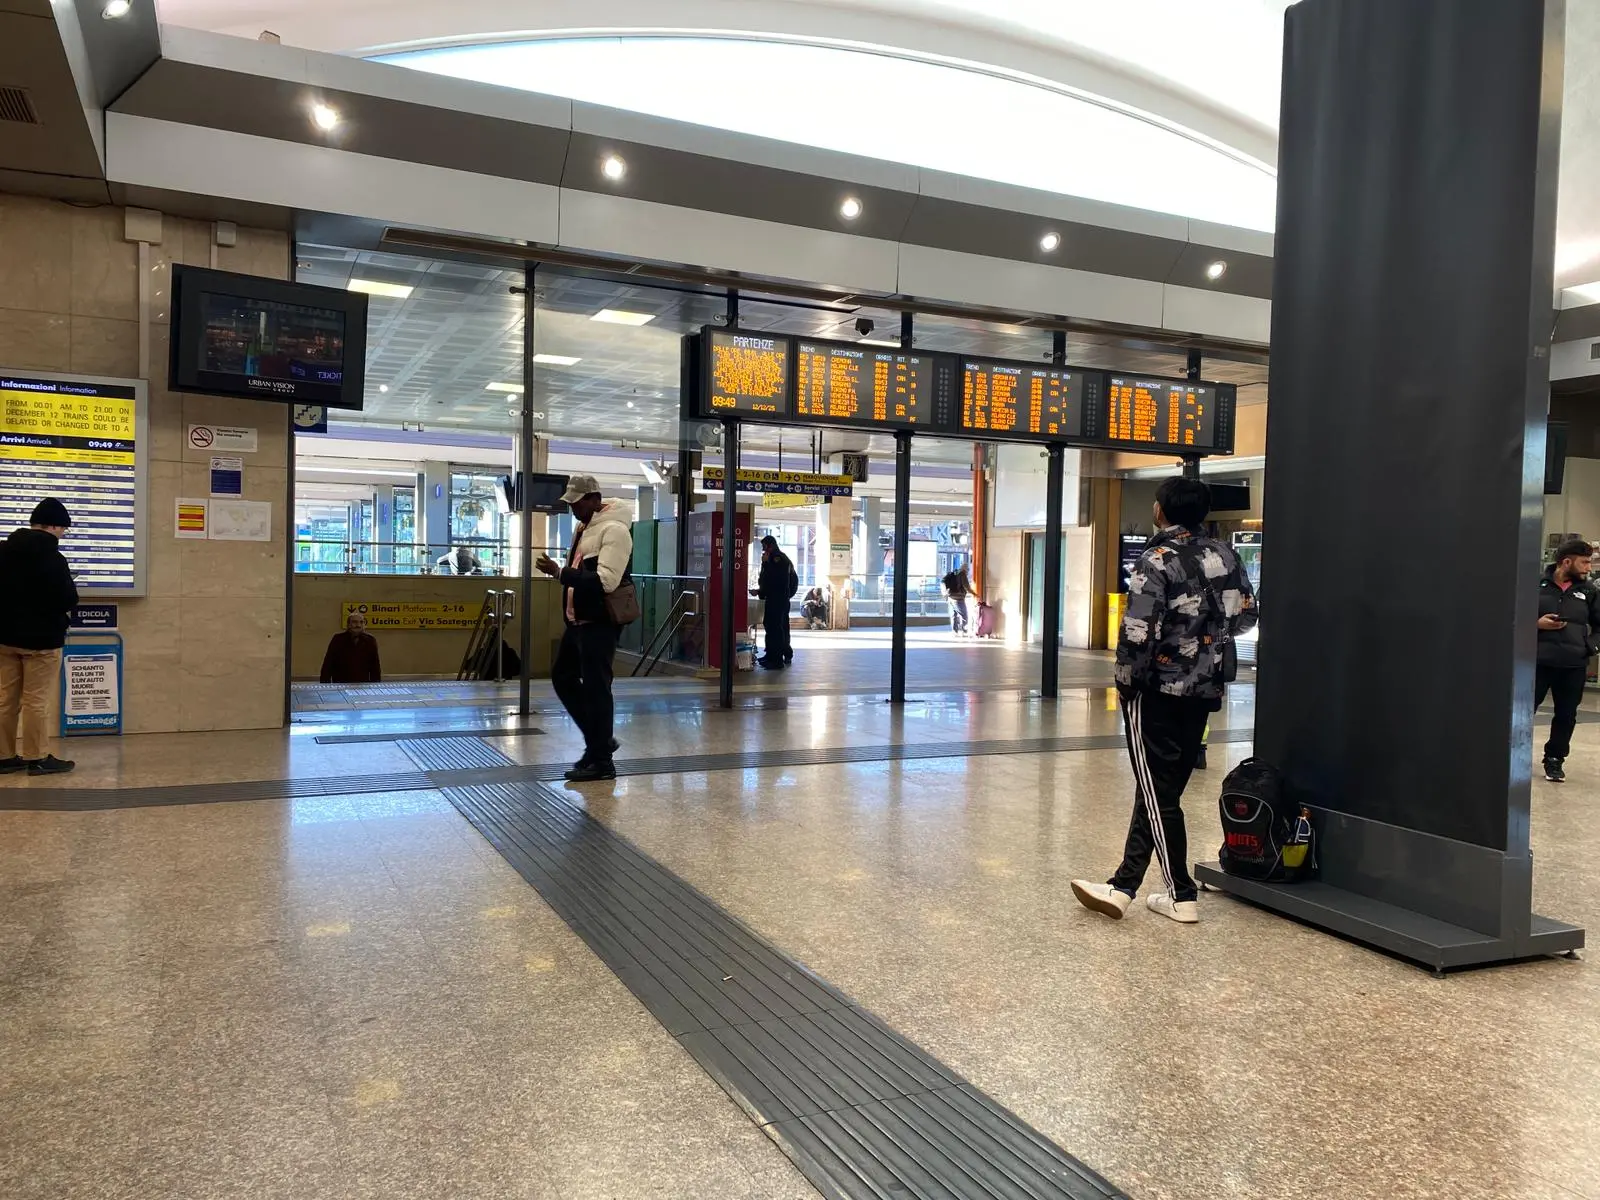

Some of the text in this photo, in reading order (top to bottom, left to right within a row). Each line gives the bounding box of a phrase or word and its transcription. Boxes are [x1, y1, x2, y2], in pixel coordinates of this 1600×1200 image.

[734, 336, 774, 350] PARTENZE
[1, 381, 97, 394] Informazioni Information
[712, 396, 736, 407] 09:49
[6, 409, 45, 417] DECEMBER
[56, 421, 89, 429] CHANGED
[67, 716, 117, 725] Bresciaoggi
